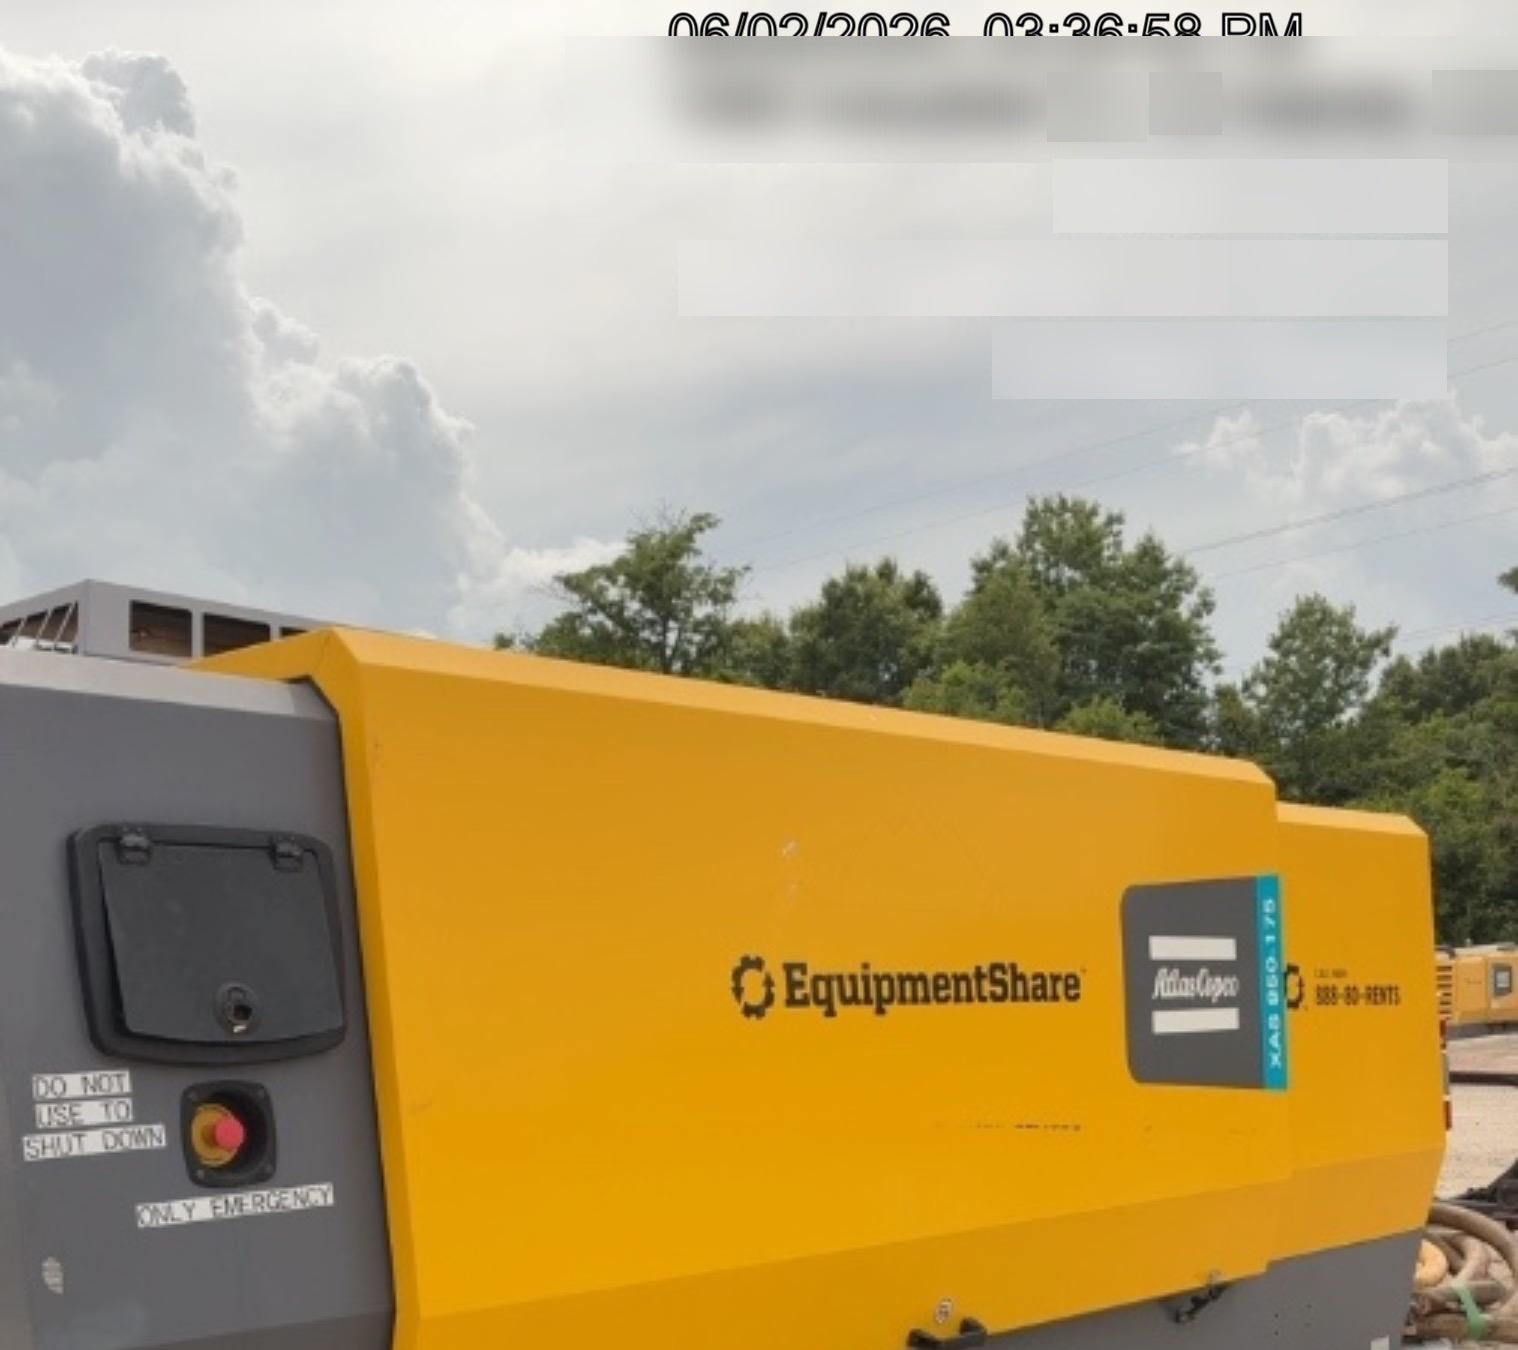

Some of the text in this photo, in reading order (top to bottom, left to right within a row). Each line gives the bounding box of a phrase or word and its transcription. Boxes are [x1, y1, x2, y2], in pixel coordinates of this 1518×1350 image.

[783, 961, 1081, 1017] EquipmentShare
[34, 1073, 127, 1097] DO NOT
[37, 1100, 131, 1127] USE TO
[25, 1126, 162, 1159] SHUT DOWN
[138, 1185, 331, 1226] ONLY EMERGENCY
